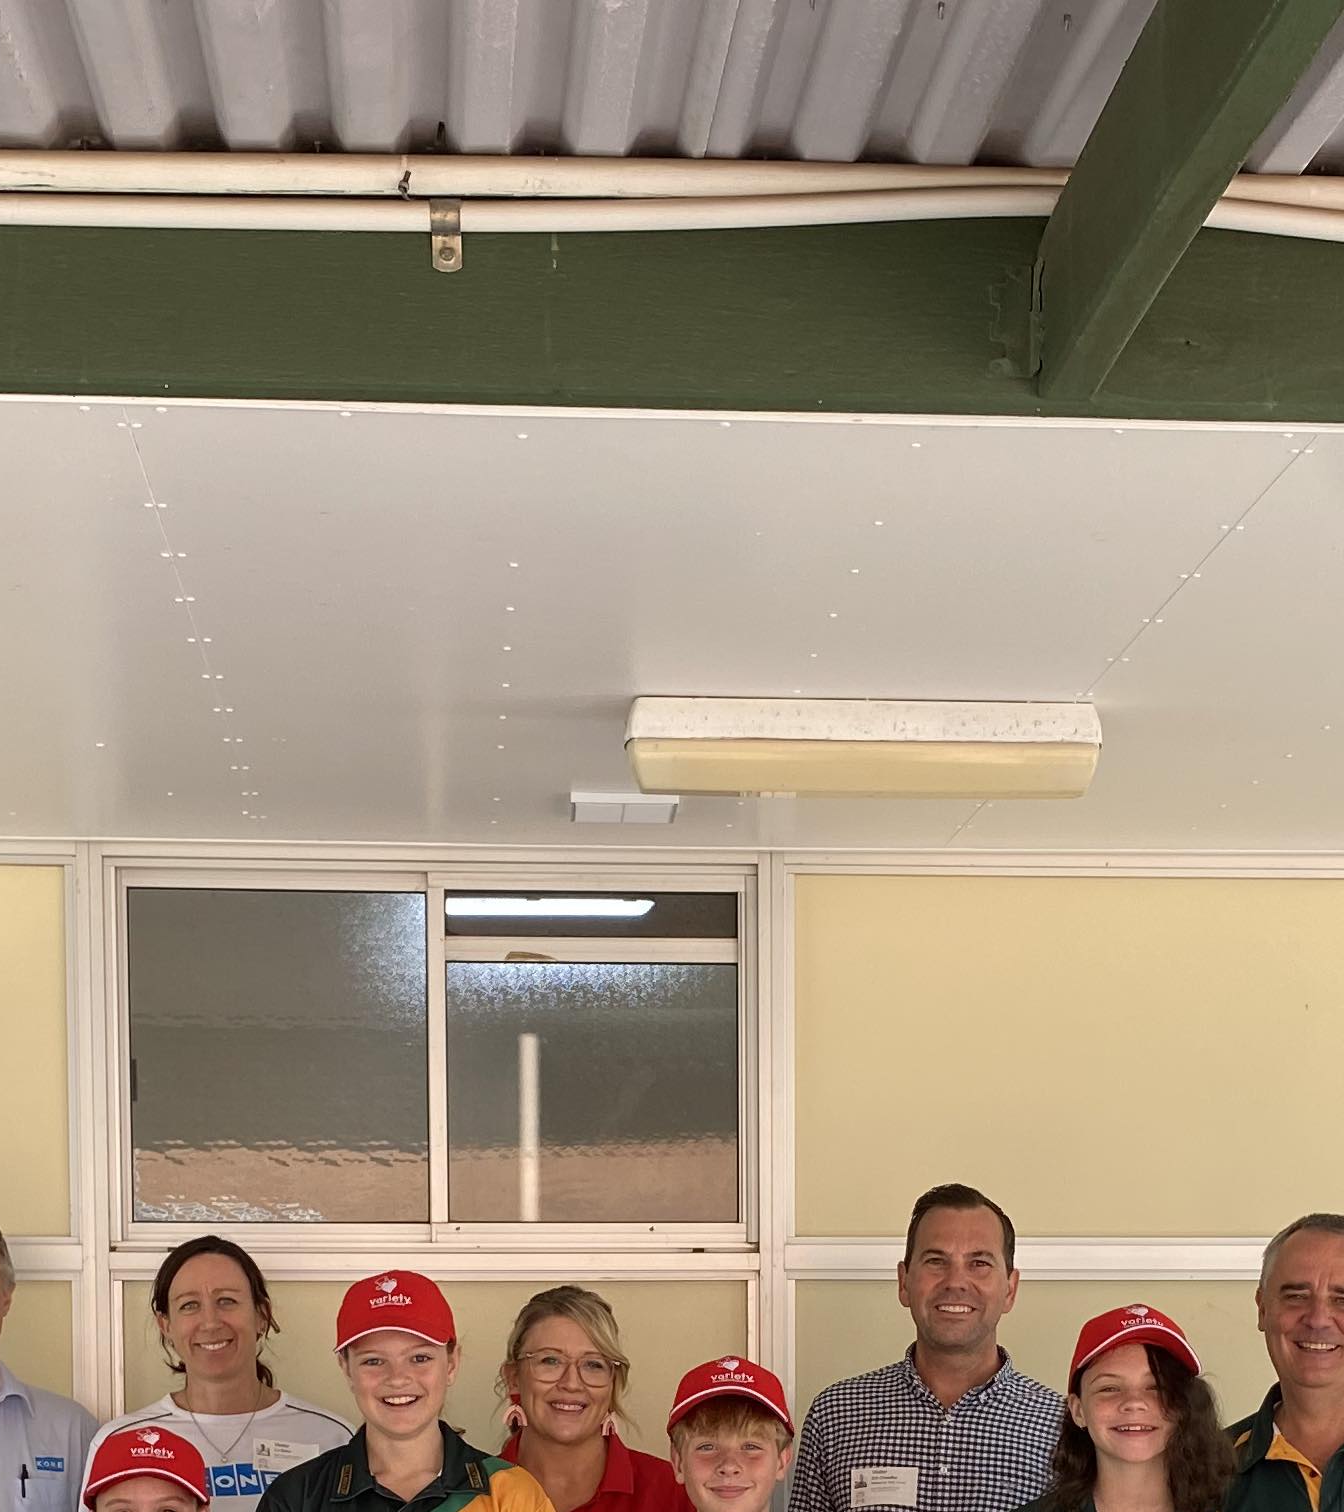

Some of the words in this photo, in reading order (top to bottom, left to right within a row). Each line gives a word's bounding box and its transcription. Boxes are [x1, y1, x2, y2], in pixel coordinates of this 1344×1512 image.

[369, 1293, 412, 1305] variety
[711, 1371, 754, 1382] variety
[130, 1446, 174, 1458] variety
[37, 1459, 64, 1470] KONE
